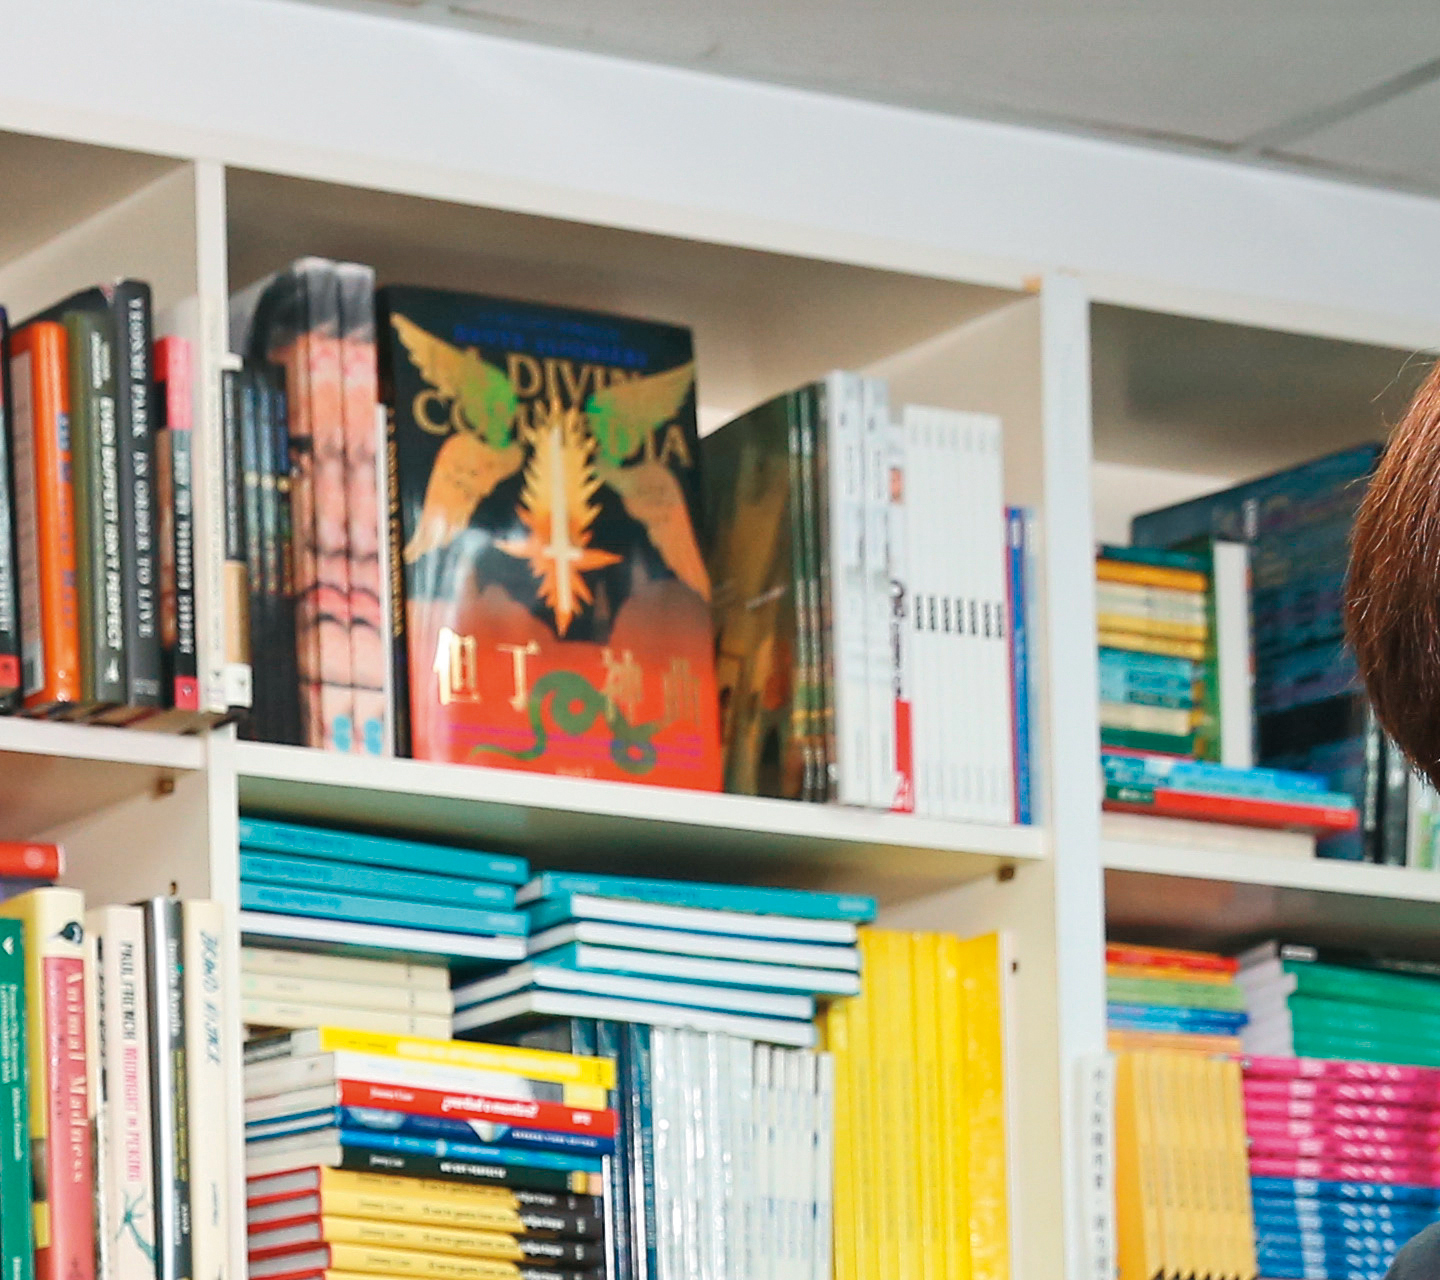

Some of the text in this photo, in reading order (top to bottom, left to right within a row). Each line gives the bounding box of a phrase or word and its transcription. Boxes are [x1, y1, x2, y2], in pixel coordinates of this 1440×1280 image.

[131, 384, 147, 438] PARK
[137, 557, 151, 584] TO
[104, 571, 121, 649] PERFECT
[138, 589, 154, 638] LIVE
[66, 972, 90, 1183] Animal Madness
